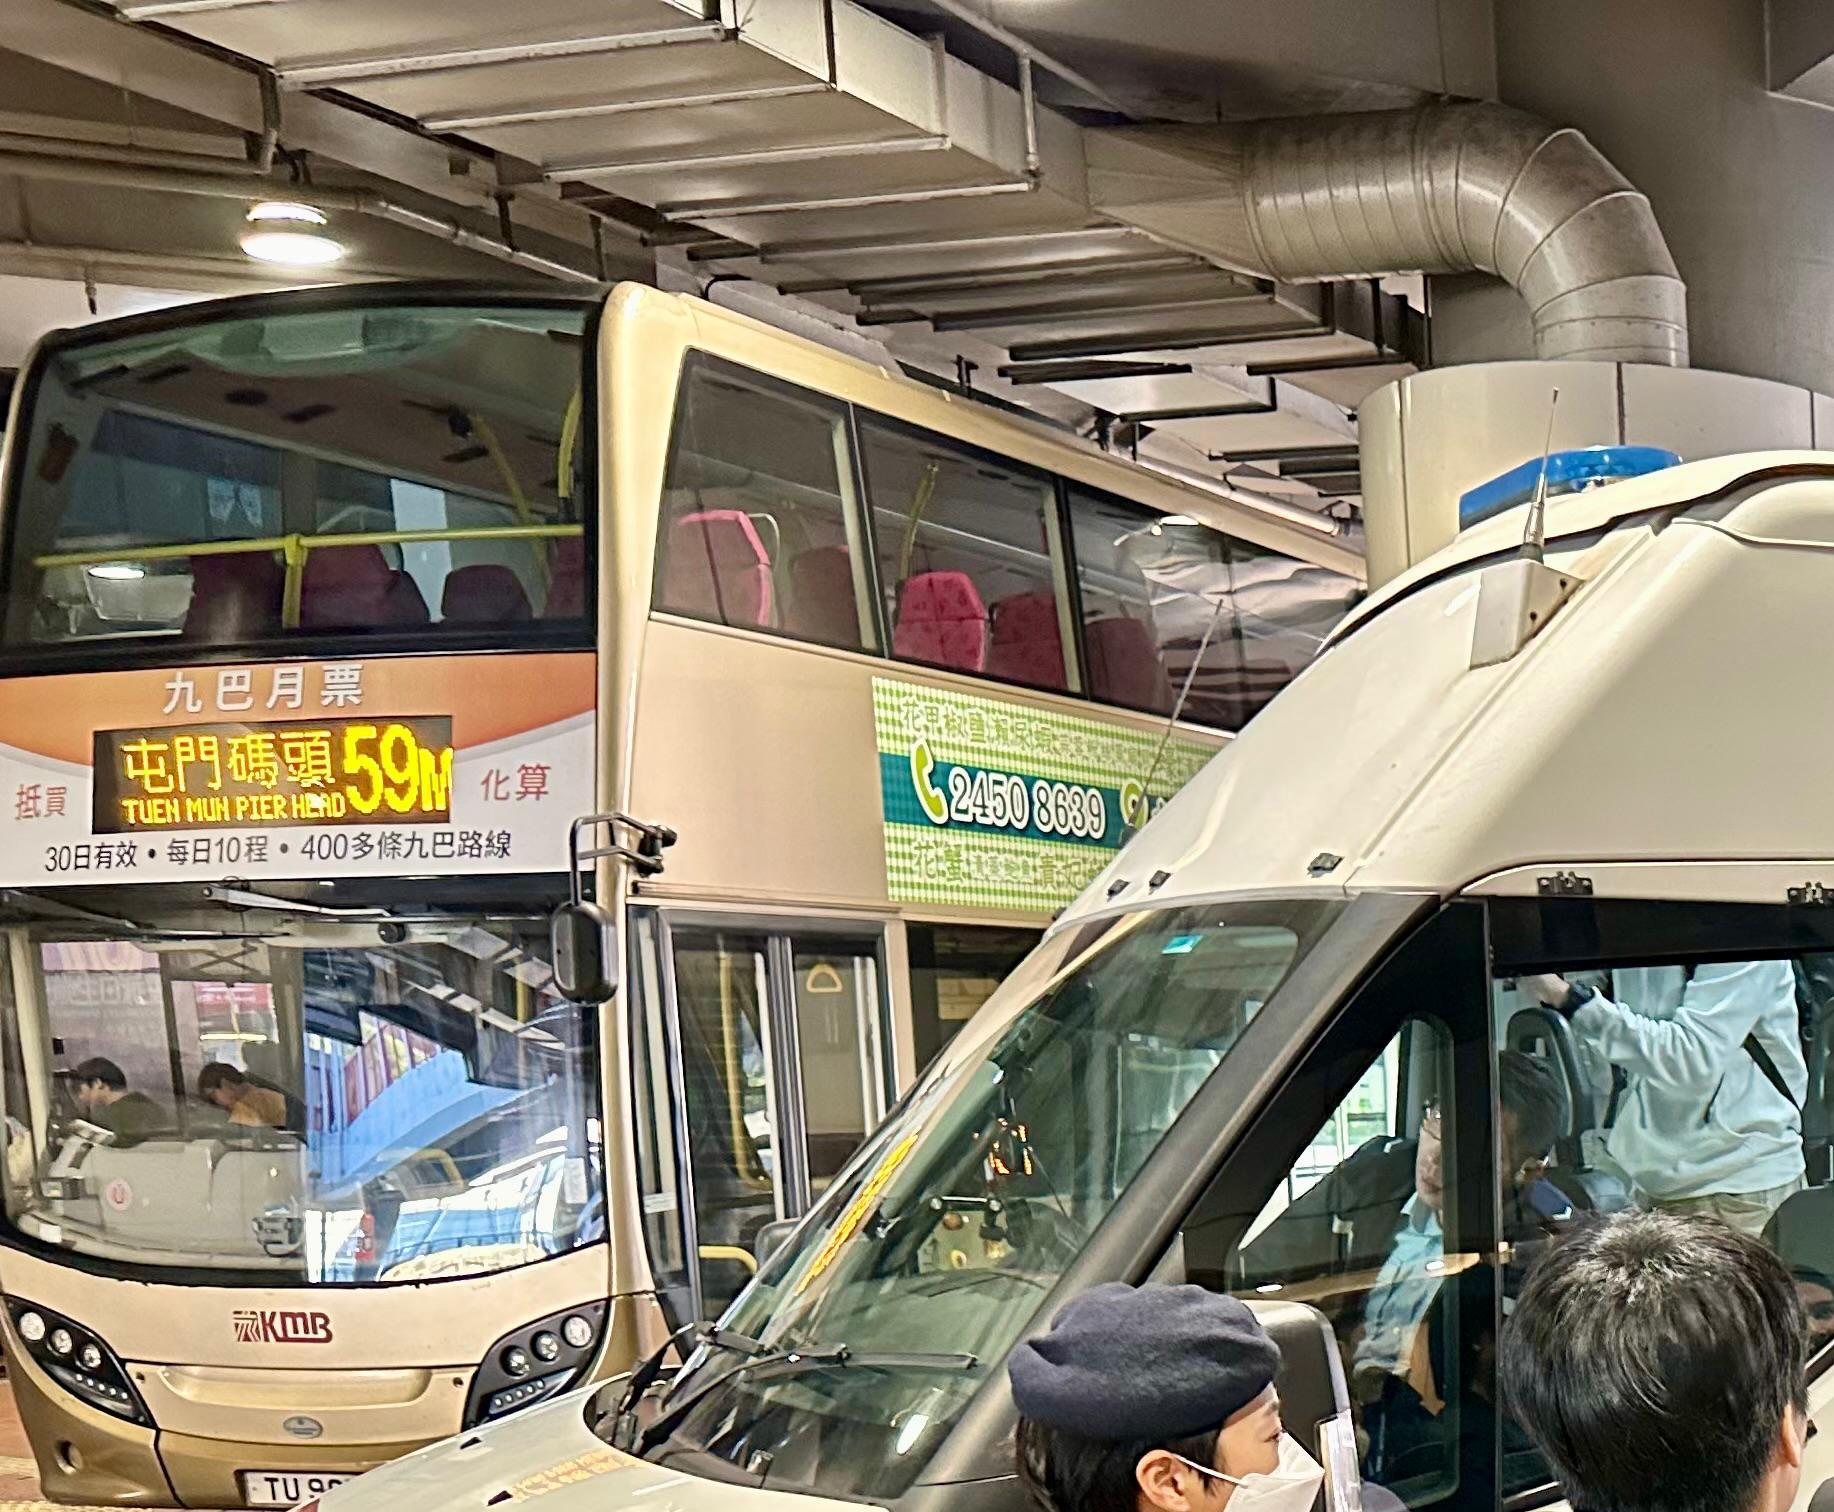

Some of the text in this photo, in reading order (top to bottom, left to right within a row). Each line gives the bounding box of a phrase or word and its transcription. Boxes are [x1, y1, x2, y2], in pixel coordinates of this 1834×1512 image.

[163, 664, 362, 714] 九巴月票
[121, 731, 335, 794] 屯門碼頭
[343, 724, 453, 814] 59M
[481, 764, 551, 801] 化算
[121, 791, 346, 824] TUEN MUN PIER HEAD
[949, 767, 1106, 840] 2450 8639
[44, 830, 512, 871] 30日有效 每日10程 400多條九巴路線
[260, 1311, 333, 1343] KMB
[265, 1477, 299, 1501] TU
